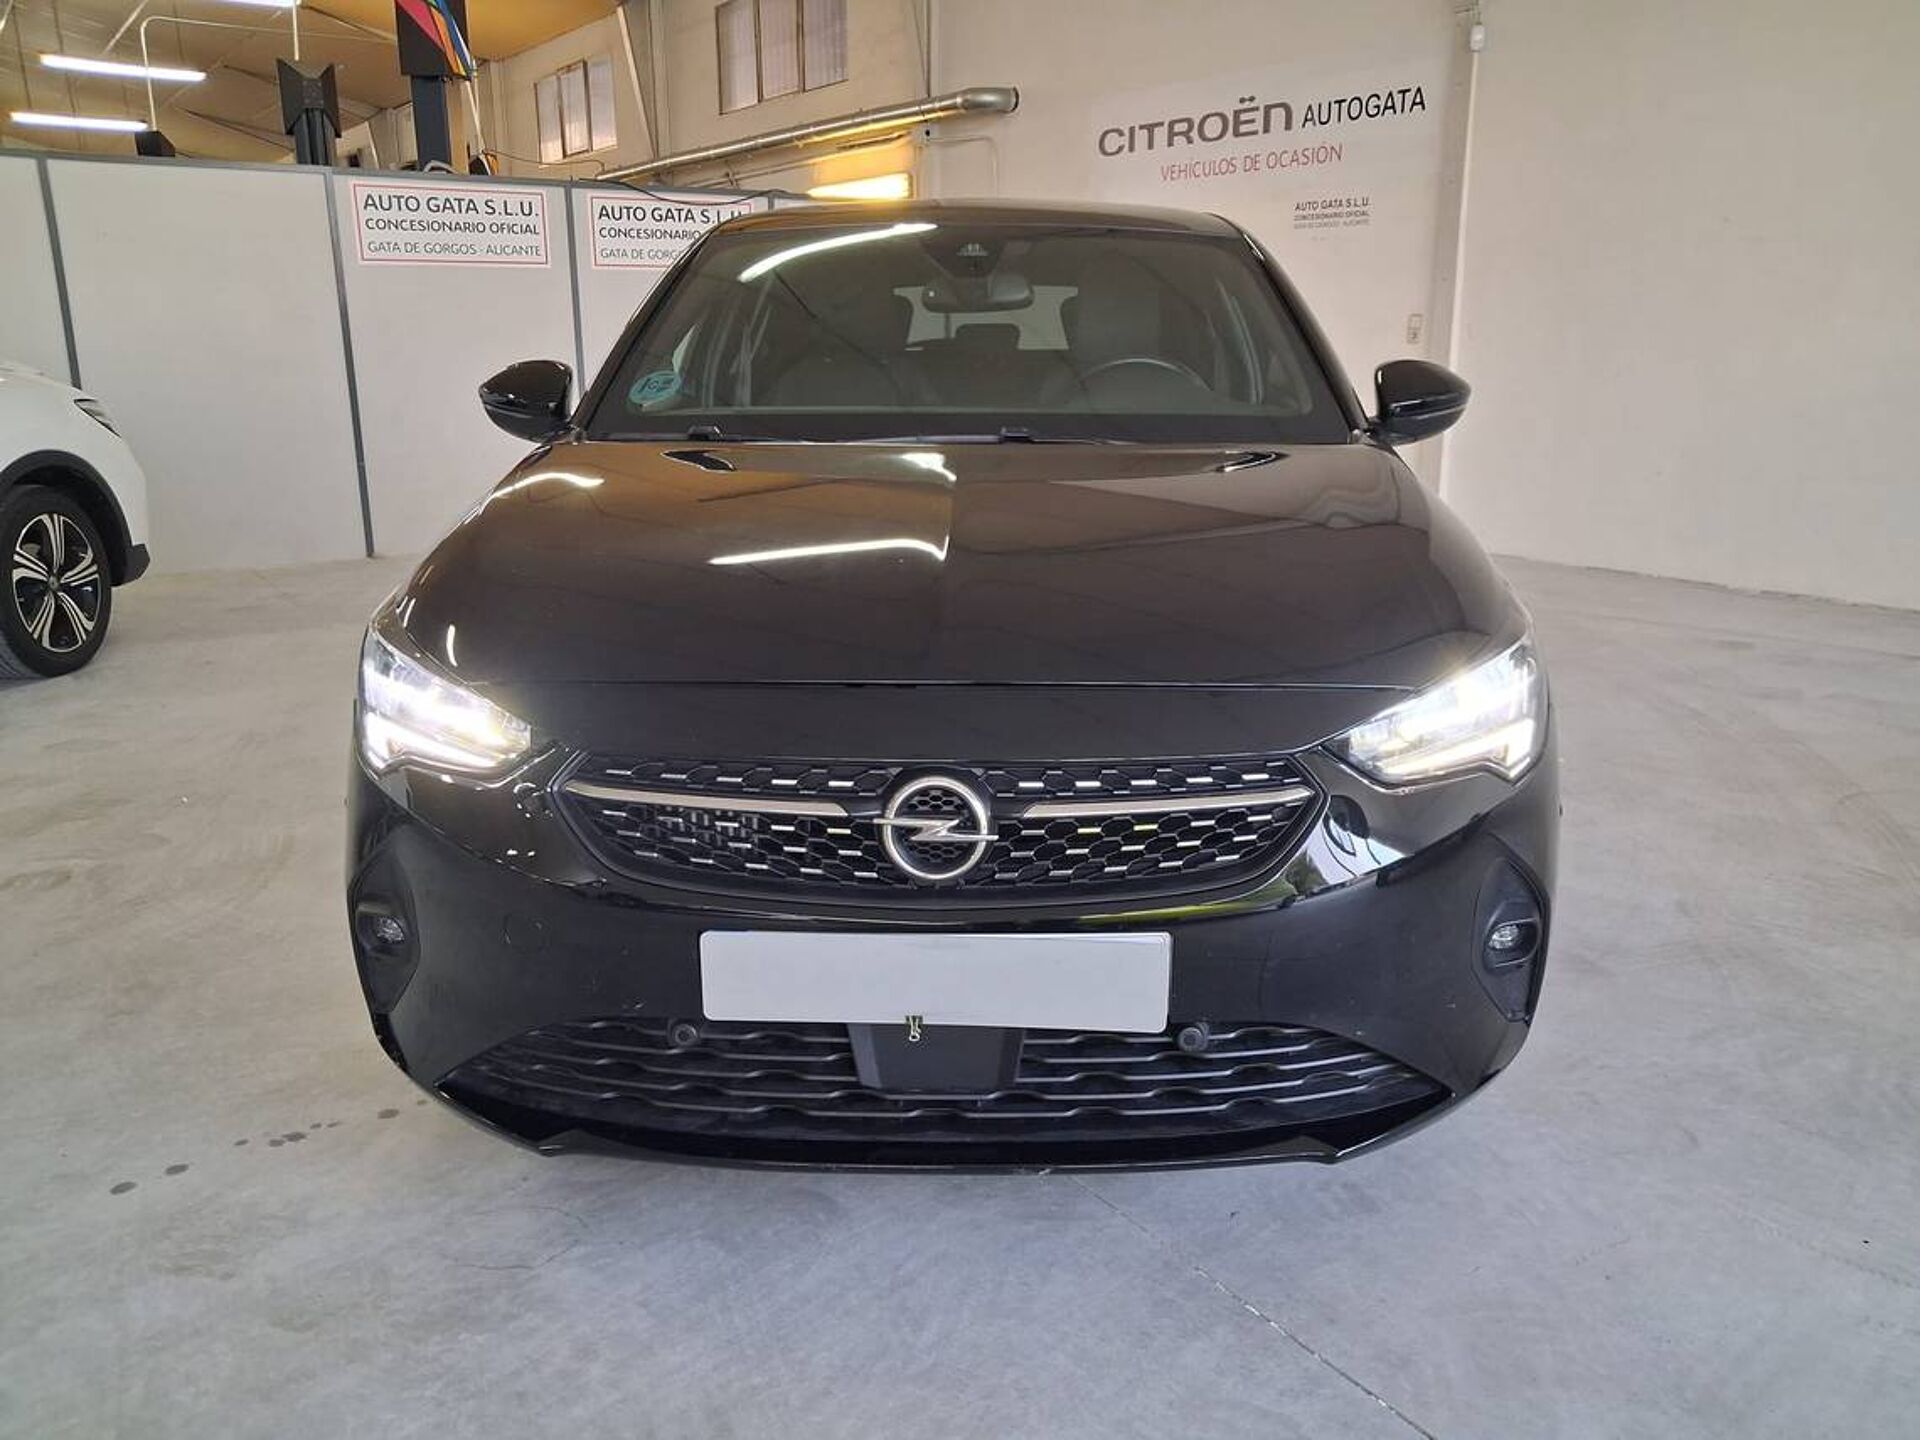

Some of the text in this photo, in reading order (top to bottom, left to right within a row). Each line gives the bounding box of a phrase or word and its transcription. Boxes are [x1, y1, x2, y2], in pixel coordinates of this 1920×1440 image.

[1302, 86, 1426, 129] AUTOGATA
[1243, 155, 1260, 173] DE
[1266, 143, 1343, 169] OCASIÓN
[363, 194, 539, 217] AUTO GATA S.L.U.
[598, 204, 646, 222] AUTO
[651, 207, 696, 223] GATA
[1295, 200, 1319, 211] AUTO
[1320, 199, 1343, 210] GATA
[365, 218, 540, 235] CONCESIONARIO OFICIAL
[599, 227, 702, 240] CONCESIONARIO
[368, 241, 401, 253] GATA
[404, 242, 419, 254] DE
[424, 242, 477, 255] GORGOS
[486, 244, 541, 256] ALICANTE
[601, 248, 628, 259] GATA
[631, 249, 645, 260] DE
